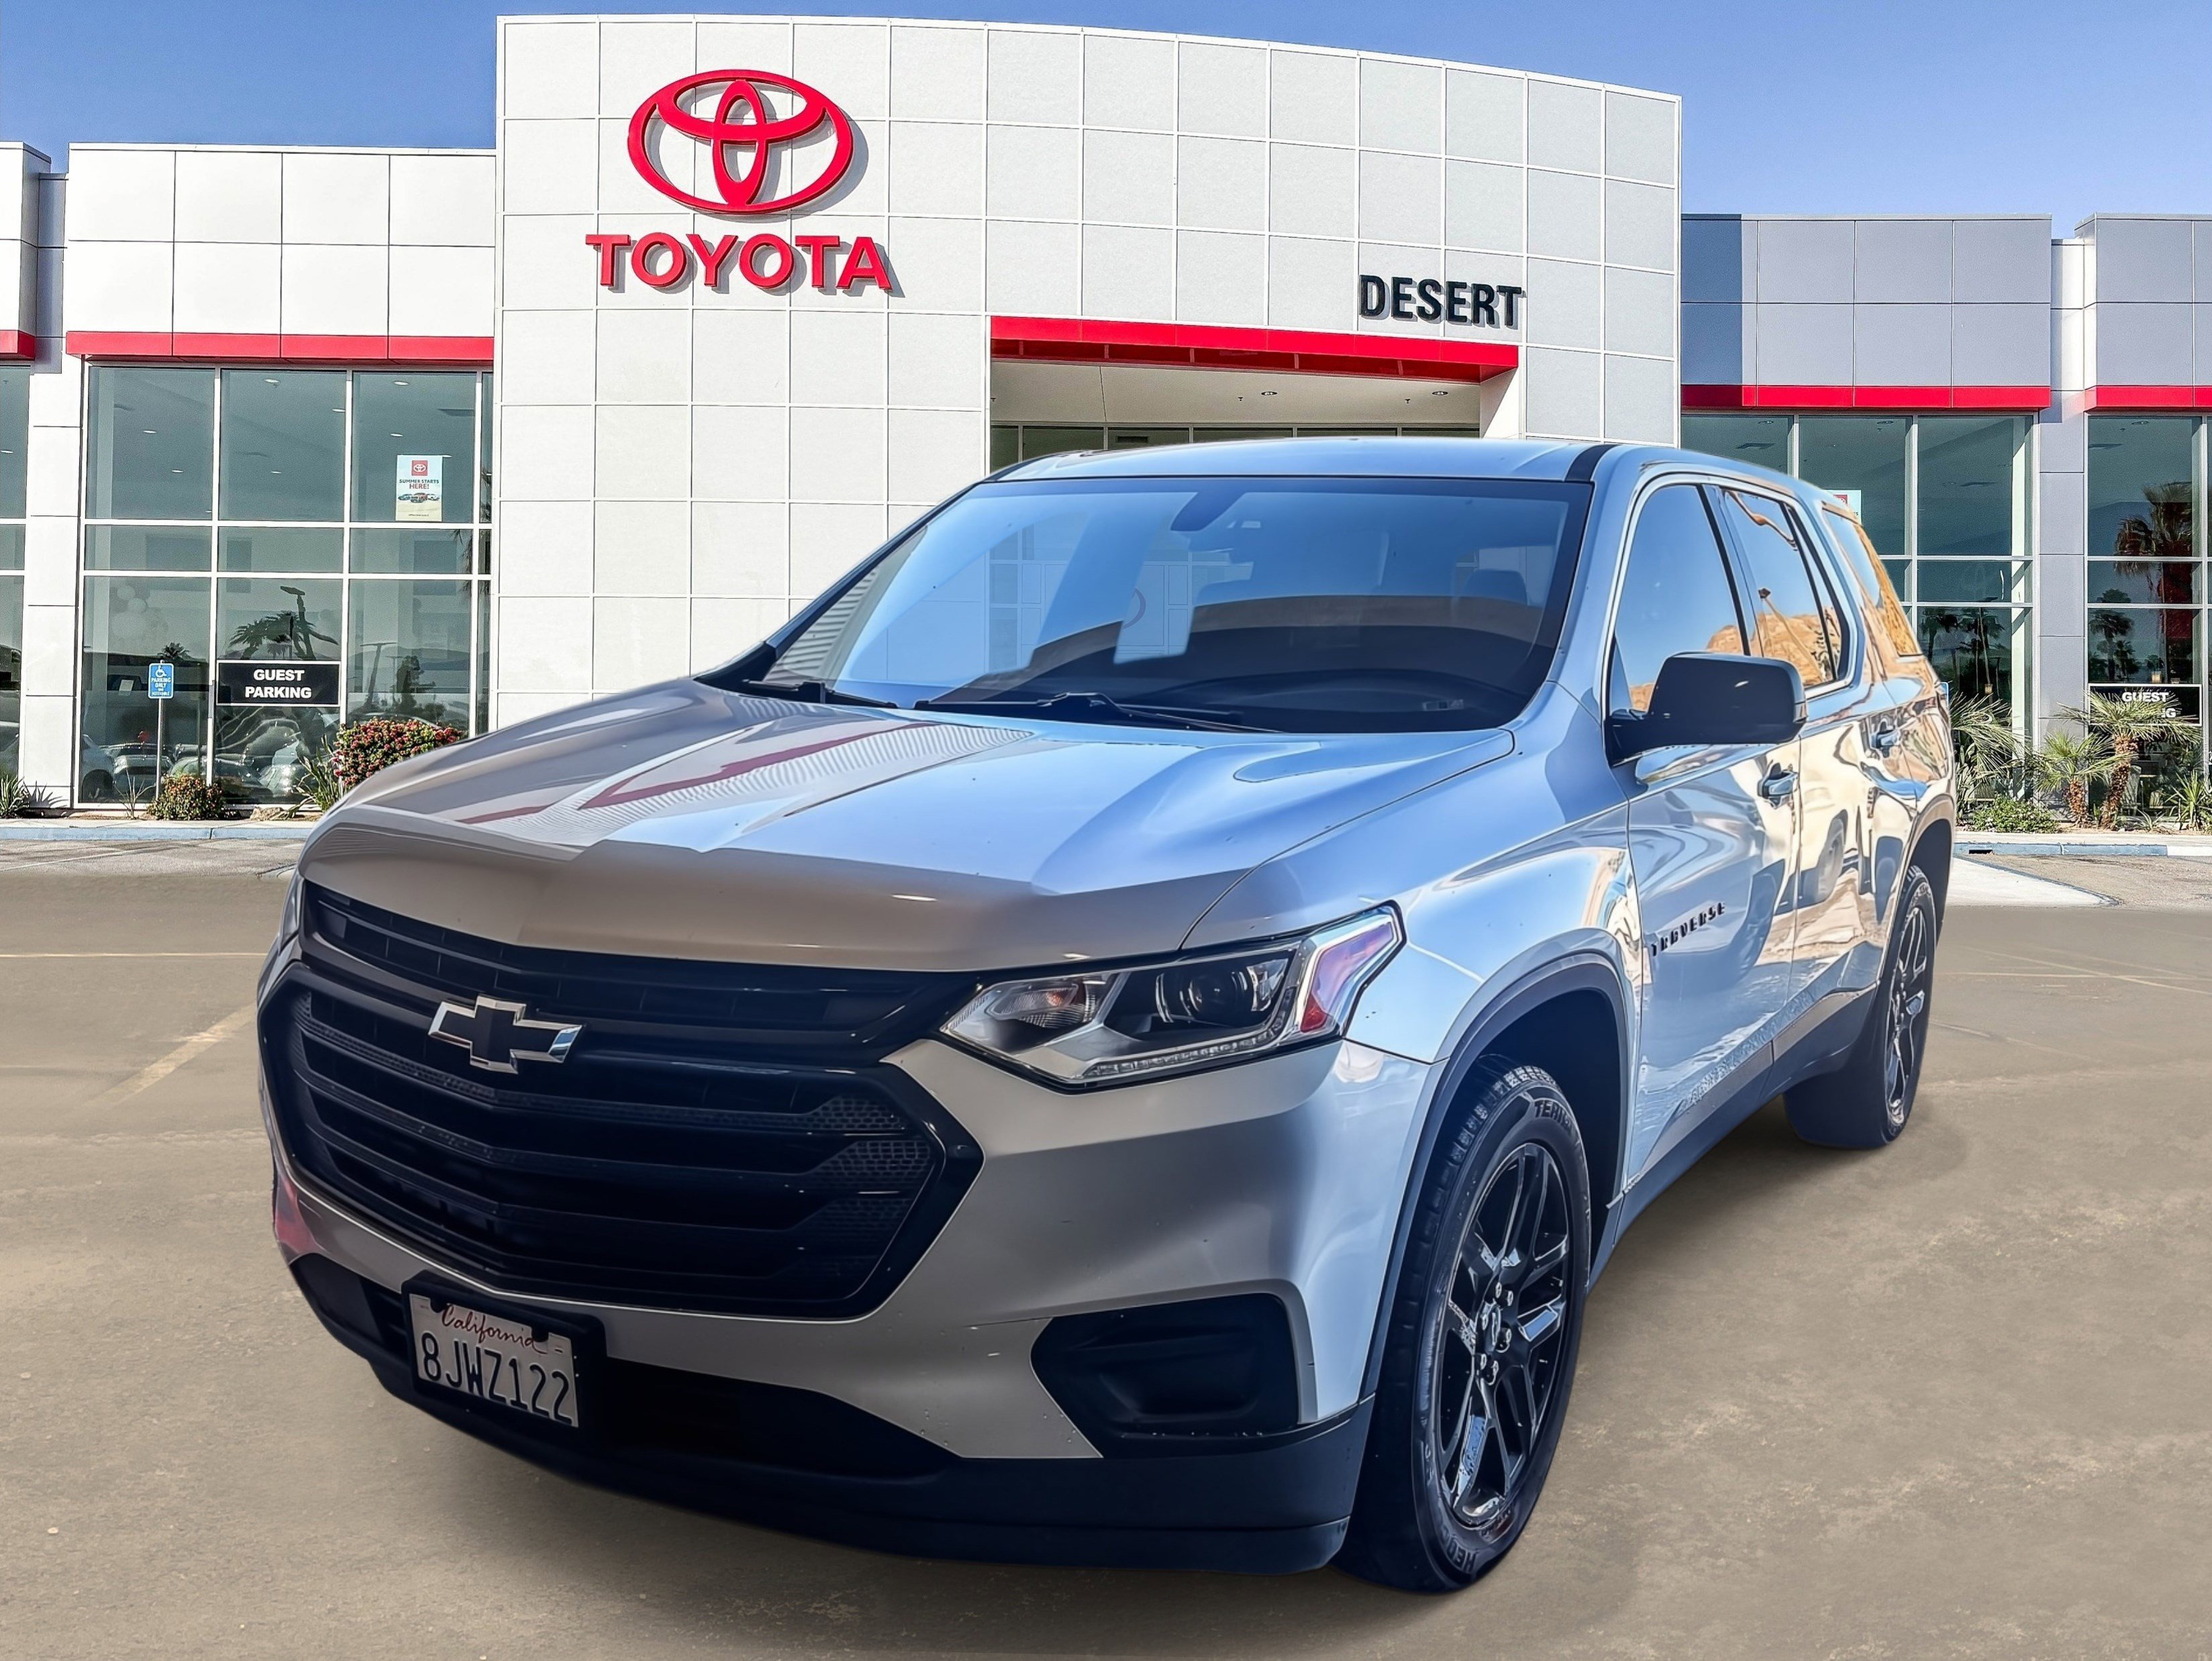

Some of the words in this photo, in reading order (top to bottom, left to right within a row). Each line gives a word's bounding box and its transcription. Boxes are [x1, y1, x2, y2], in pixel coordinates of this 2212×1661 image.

[585, 232, 893, 290] TOYOTA
[1359, 274, 1522, 326] DESERT
[245, 686, 312, 699] PARKING
[253, 669, 305, 681] GUEST
[2121, 691, 2169, 702] GUEST
[1650, 902, 1725, 956] TRAVERSE
[442, 1305, 548, 1355] California
[421, 1331, 573, 1425] 8JWZ122
